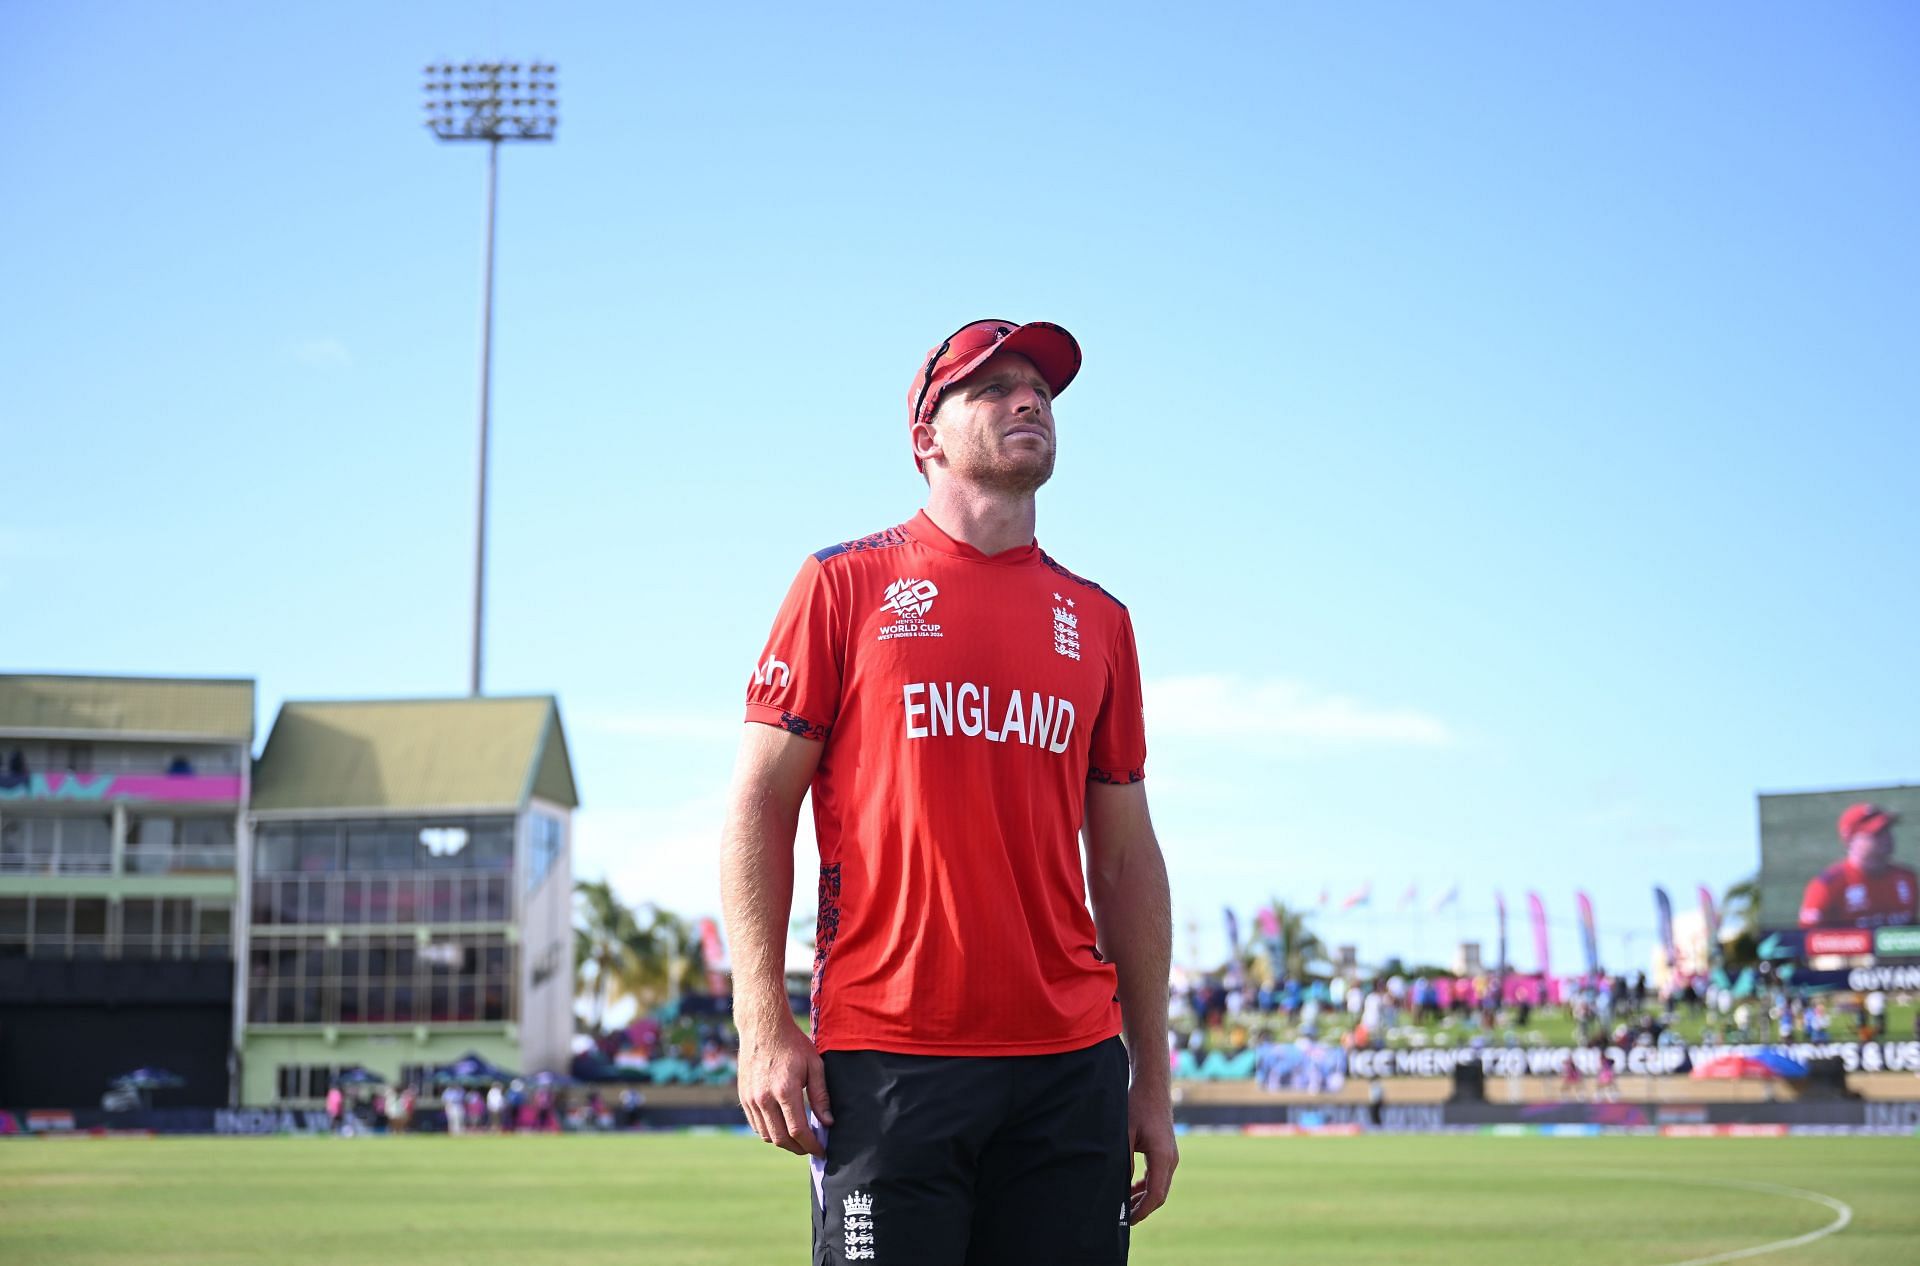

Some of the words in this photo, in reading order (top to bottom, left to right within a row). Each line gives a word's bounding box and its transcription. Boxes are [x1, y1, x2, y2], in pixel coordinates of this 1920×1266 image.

[879, 625, 918, 635] WORLD
[920, 624, 941, 632] CUP
[903, 682, 1075, 754] ENGLAND
